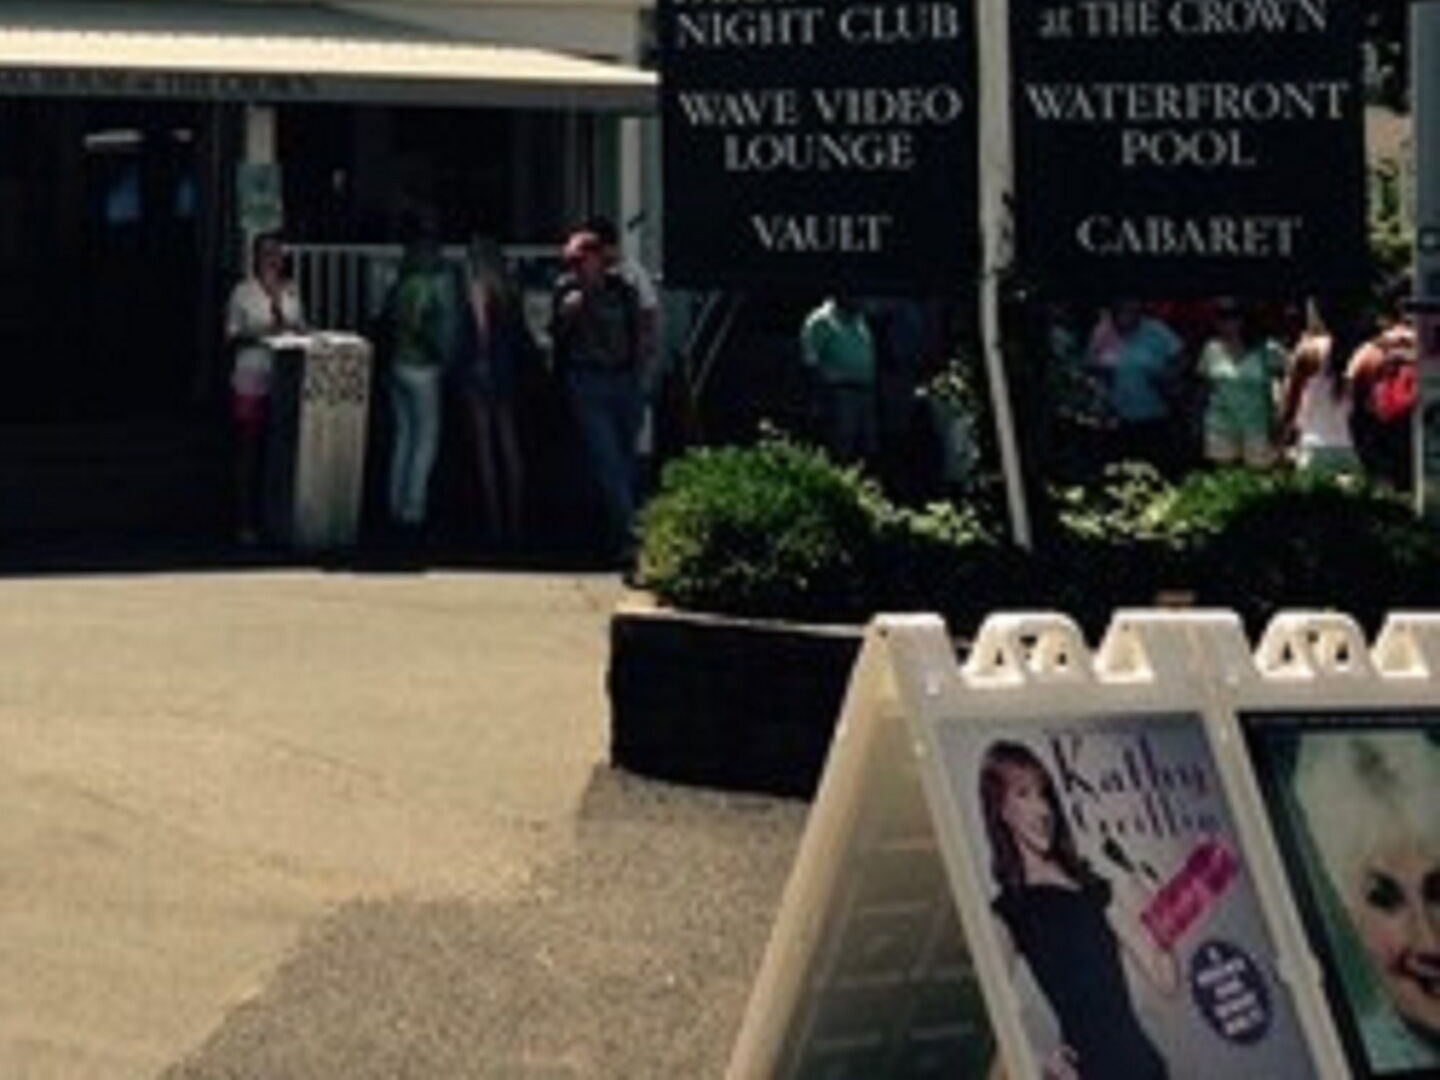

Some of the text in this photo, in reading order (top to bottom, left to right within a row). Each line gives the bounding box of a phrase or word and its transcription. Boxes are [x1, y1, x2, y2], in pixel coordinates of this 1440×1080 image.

[677, 4, 959, 46] NIGHT CLUB
[1040, 6, 1073, 37] at
[1083, 0, 1159, 35] THE
[678, 88, 960, 126] WAVE VIDEO
[1026, 82, 1349, 120] WATERFRONT
[725, 133, 913, 170] LOUNGE
[1122, 130, 1255, 166] POOL
[752, 215, 891, 251] VAULT
[1076, 216, 1301, 254] CABARET
